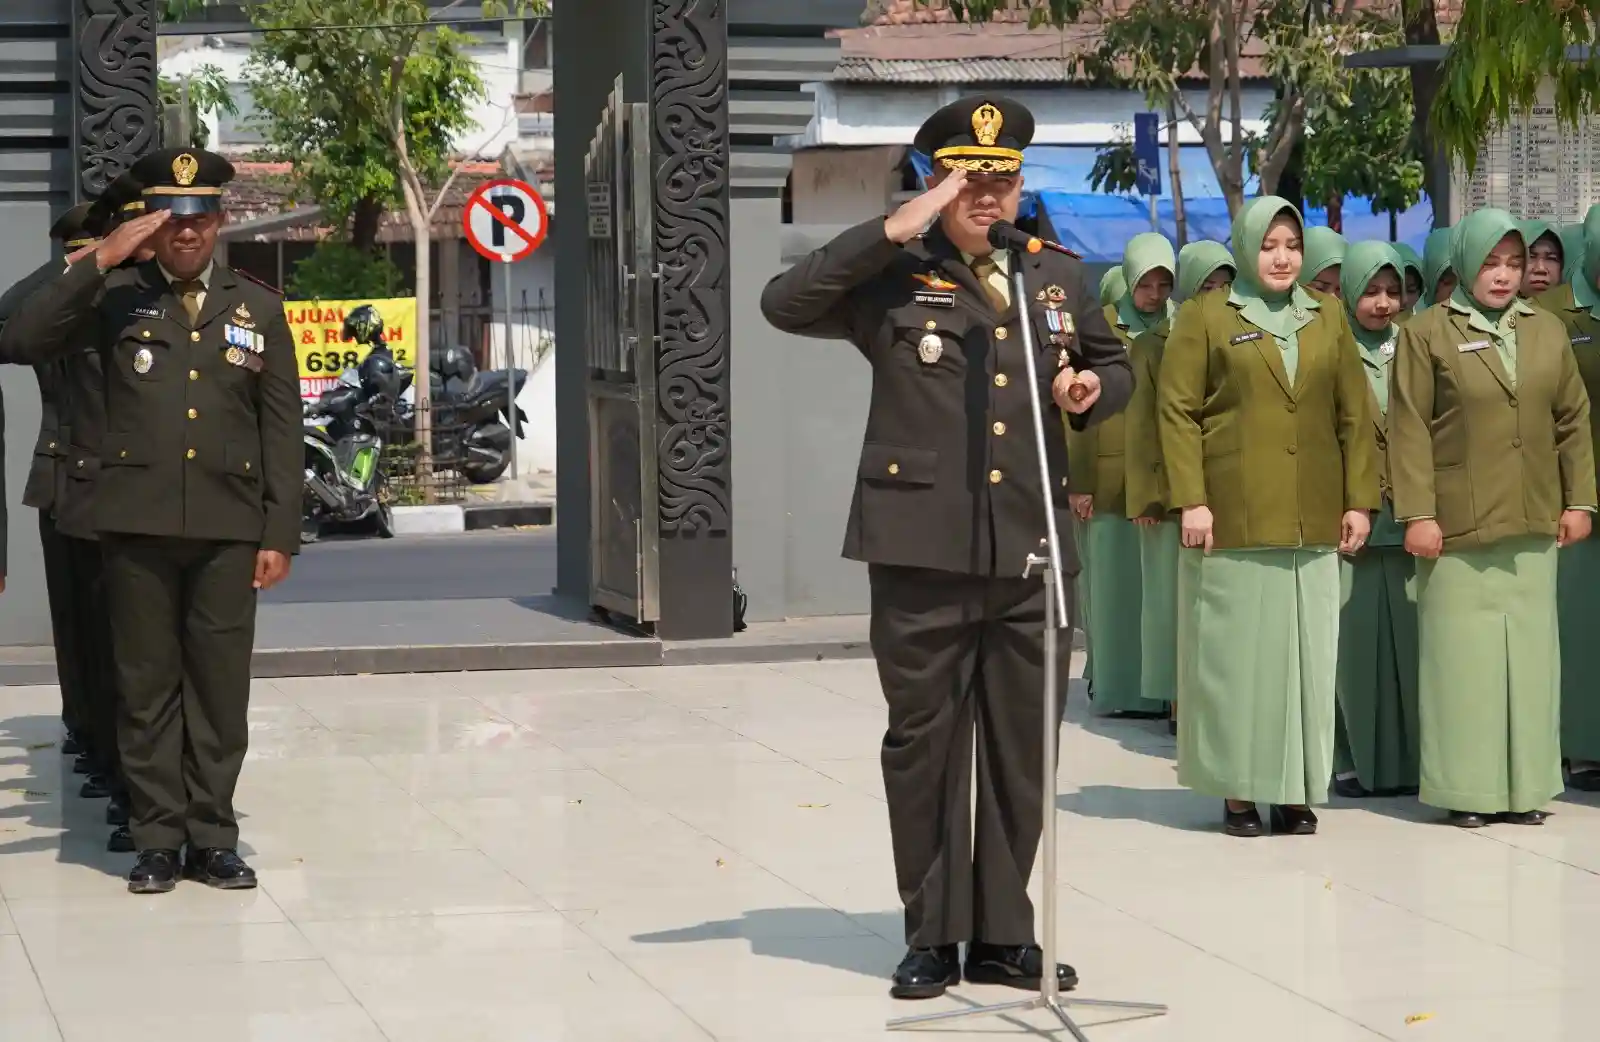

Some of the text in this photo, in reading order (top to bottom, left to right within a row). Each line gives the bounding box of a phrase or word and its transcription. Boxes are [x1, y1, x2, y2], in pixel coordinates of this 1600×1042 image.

[491, 195, 525, 246] P
[287, 307, 346, 323] IJUAL
[301, 329, 316, 345] &
[306, 350, 359, 372] 638
